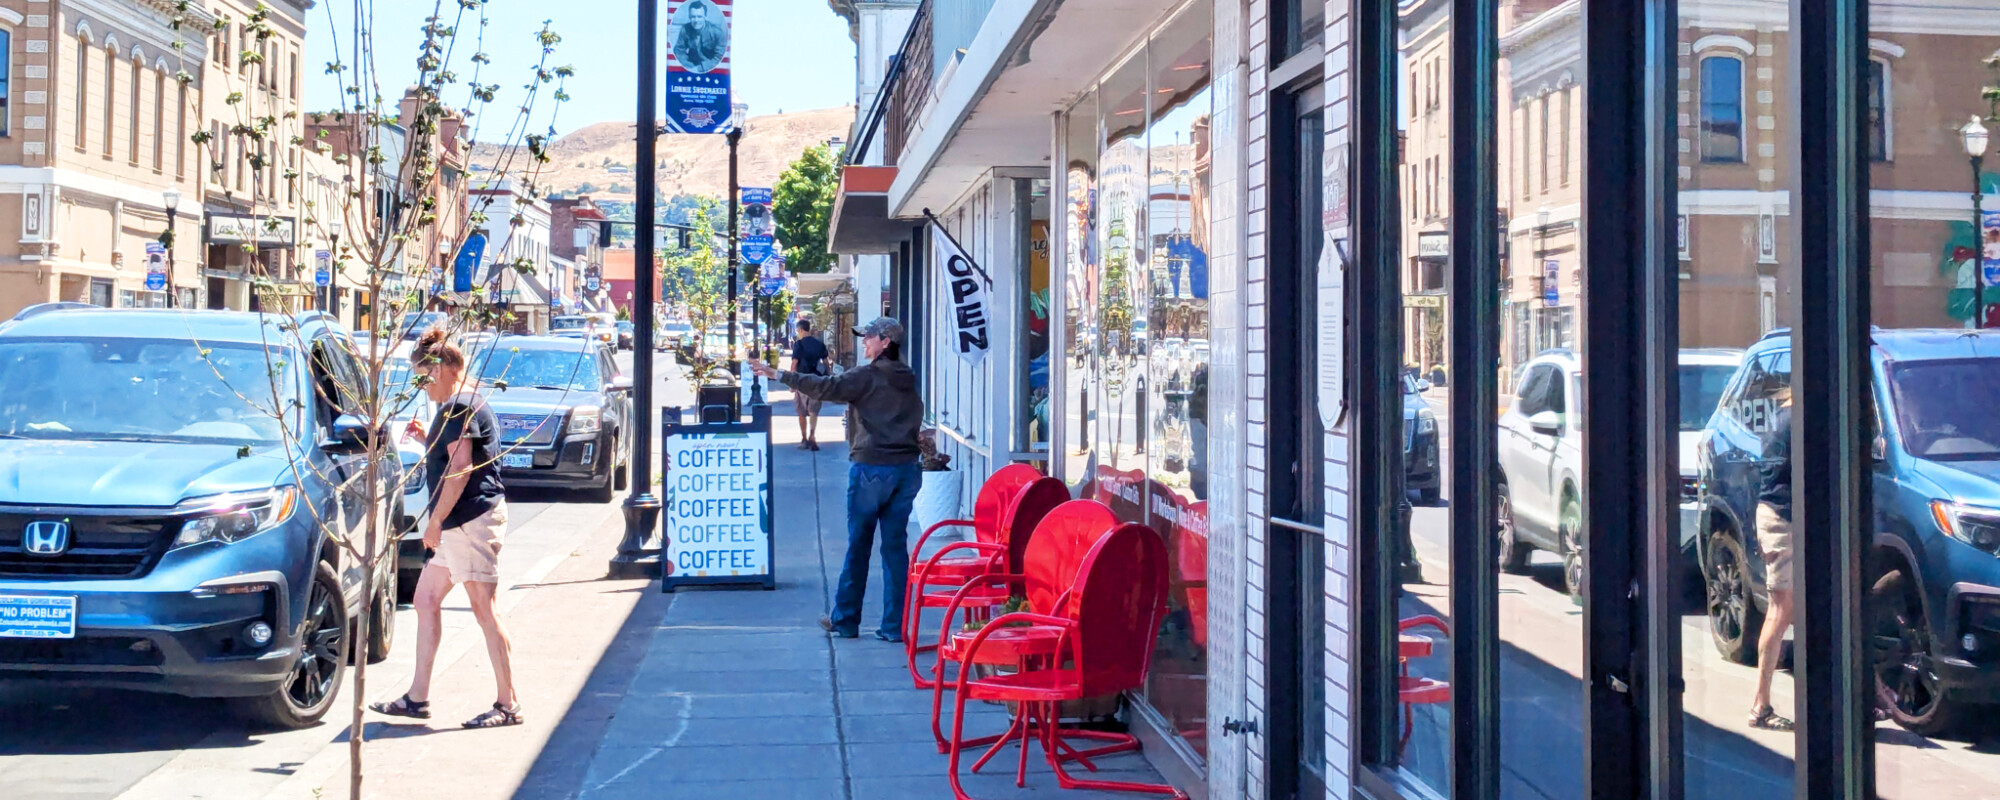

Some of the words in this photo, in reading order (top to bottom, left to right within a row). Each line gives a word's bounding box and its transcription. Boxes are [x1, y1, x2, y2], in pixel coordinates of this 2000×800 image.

[947, 254, 988, 353] OPEN
[1729, 398, 1777, 433] OPEN
[678, 449, 754, 468] COFFEE
[678, 473, 754, 492] COFFEE
[679, 498, 754, 518] COFFEE
[679, 524, 755, 543] COFFEE
[679, 549, 755, 569] COFFEE
[20, 607, 72, 619] PROBLEM"
